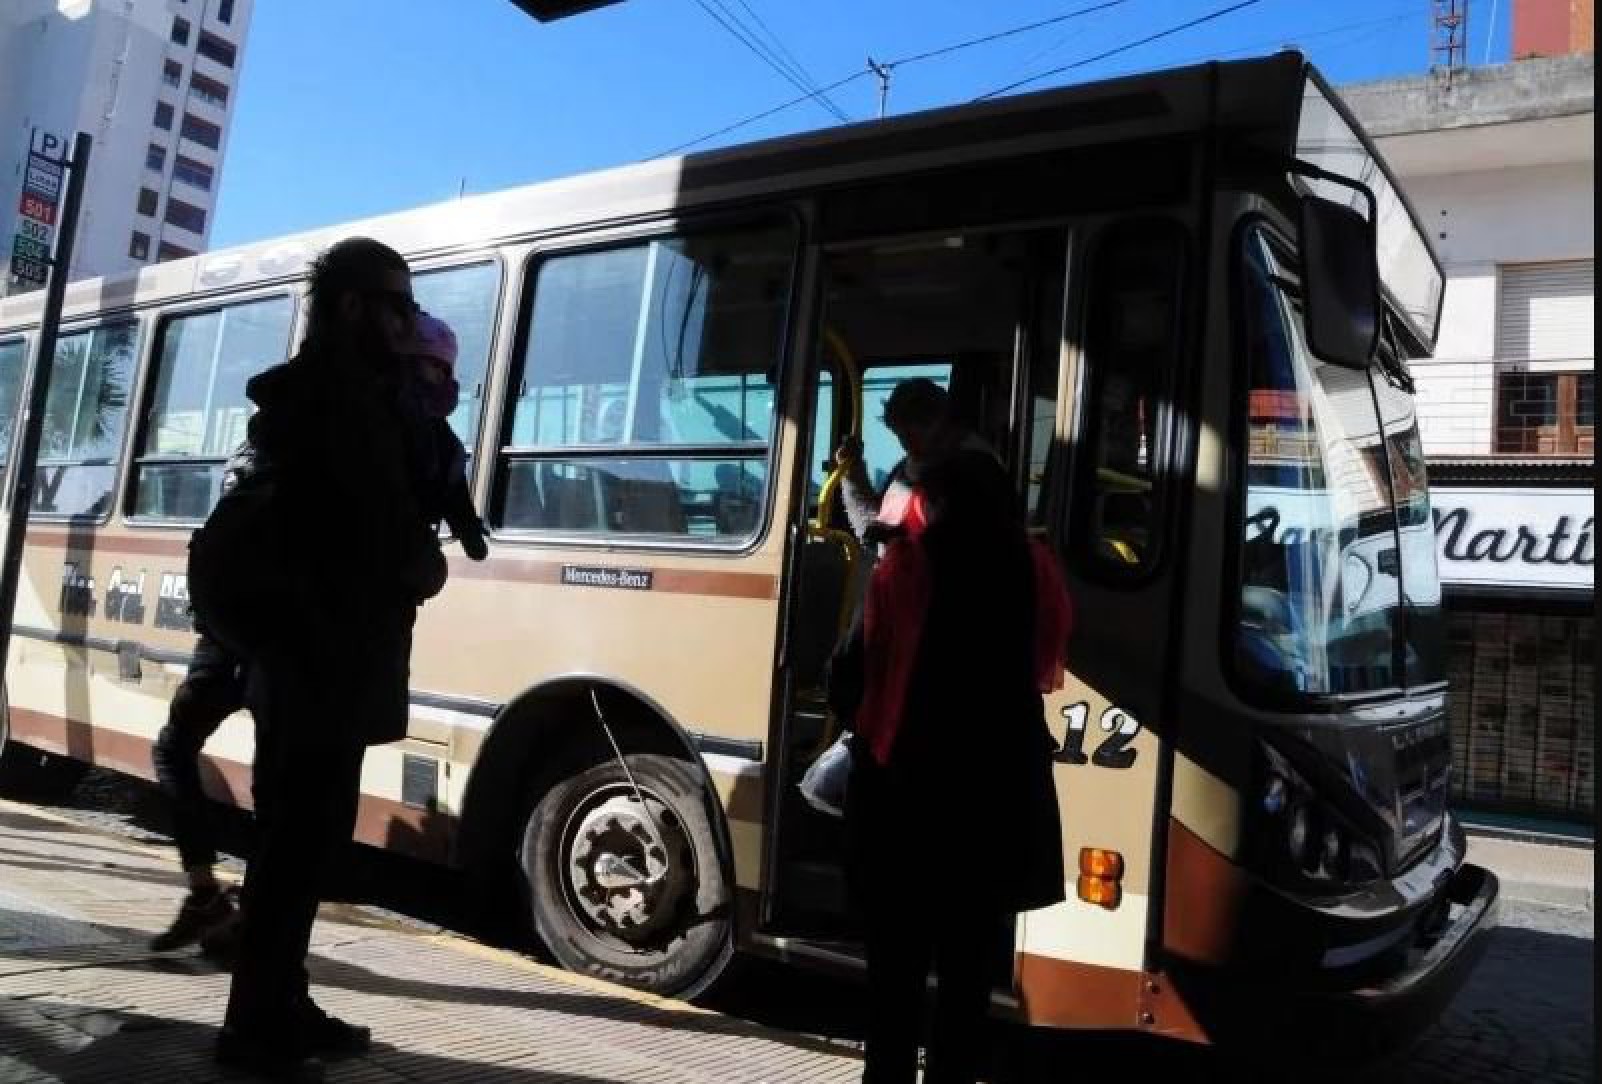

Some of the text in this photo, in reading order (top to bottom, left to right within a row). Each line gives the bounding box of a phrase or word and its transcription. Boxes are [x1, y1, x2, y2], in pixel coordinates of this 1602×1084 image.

[42, 133, 59, 153] P
[24, 198, 51, 222] 501
[22, 218, 49, 241] 502
[564, 567, 649, 587] Mercedes-Benz
[1052, 701, 1139, 769] 12
